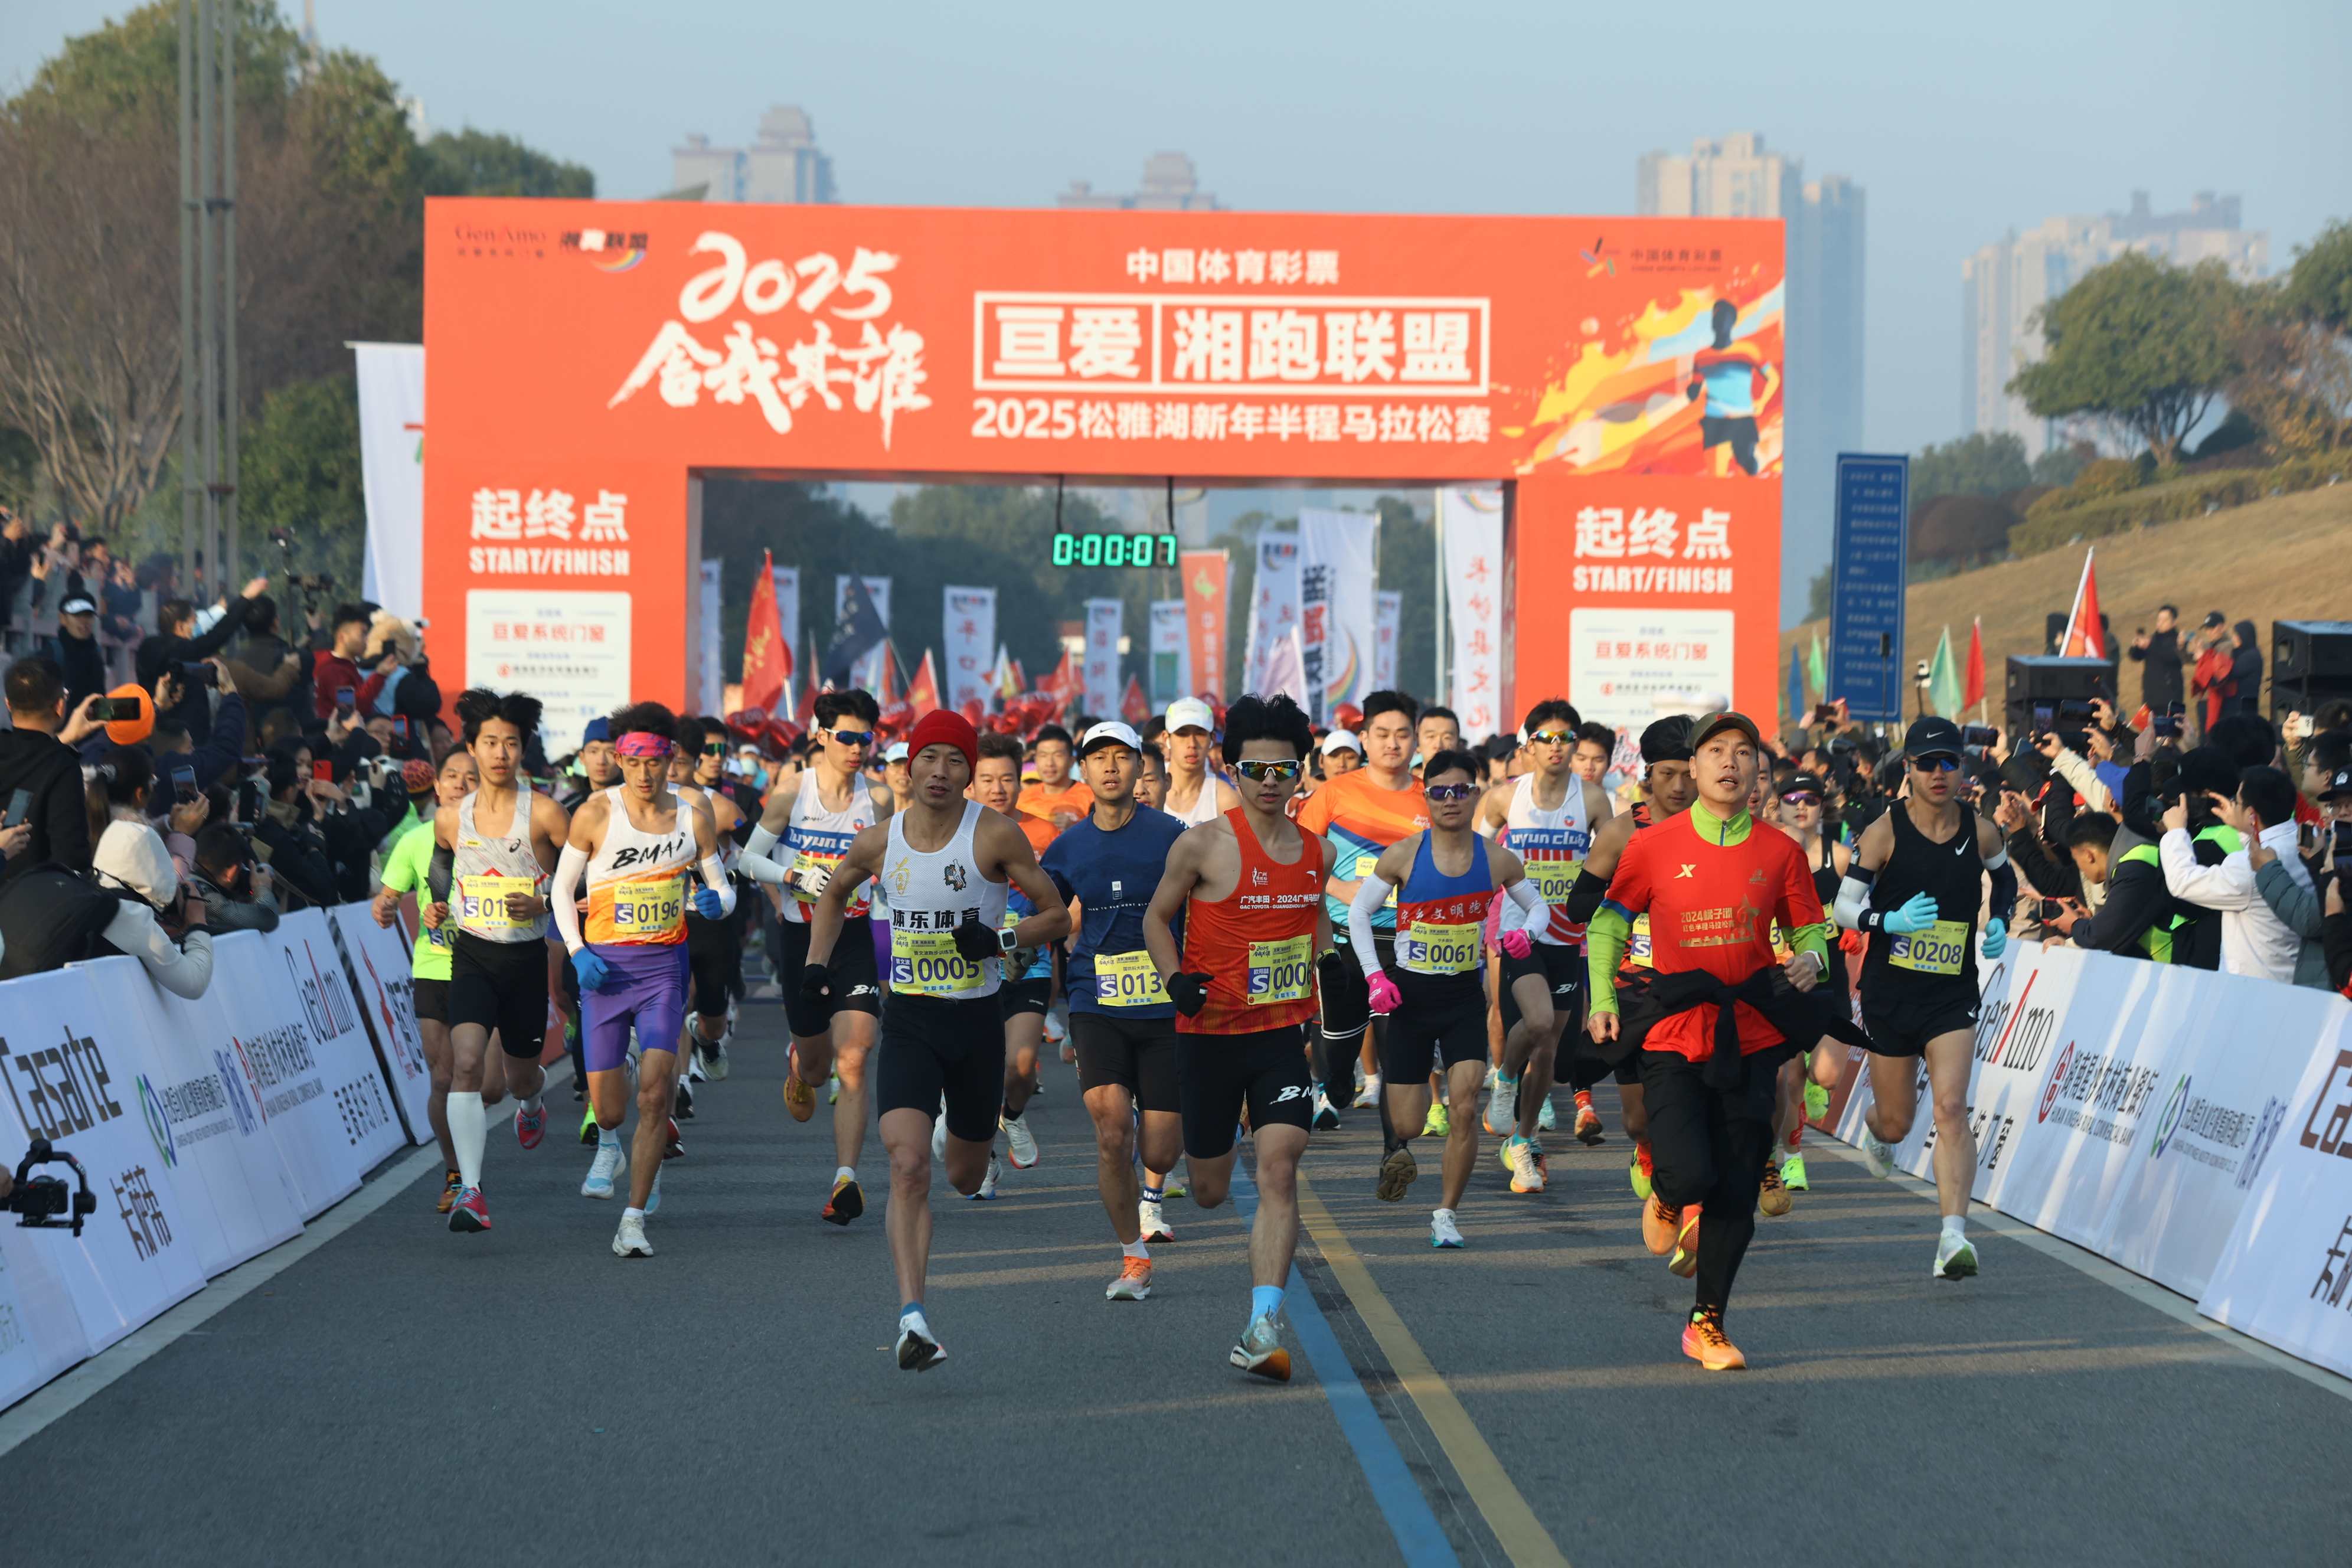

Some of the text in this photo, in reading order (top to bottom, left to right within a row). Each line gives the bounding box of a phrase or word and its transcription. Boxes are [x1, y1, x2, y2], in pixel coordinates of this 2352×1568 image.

[678, 230, 902, 324] 2025
[1126, 247, 1340, 284] 中国体育彩票
[992, 305, 1472, 383] 亘爱 湘跑联盟
[971, 397, 1491, 444] 2025松雅湖新年半程马拉松赛
[469, 487, 630, 543] 起终点
[1573, 506, 1733, 560] 起终点
[469, 547, 631, 576] START/FINISH
[1053, 533, 1177, 567] 0:00:07
[1572, 565, 1733, 594] START/FINISH
[1240, 895, 1270, 904] 广汽丰田
[1544, 878, 1575, 896] 009
[637, 898, 680, 923] 0196
[1430, 943, 1474, 963] 0061
[1913, 939, 1962, 965] 0208
[917, 956, 979, 982] 0005
[1121, 972, 1162, 997] 013
[2060, 1050, 2164, 1121] 湖南星沙农村商业银行
